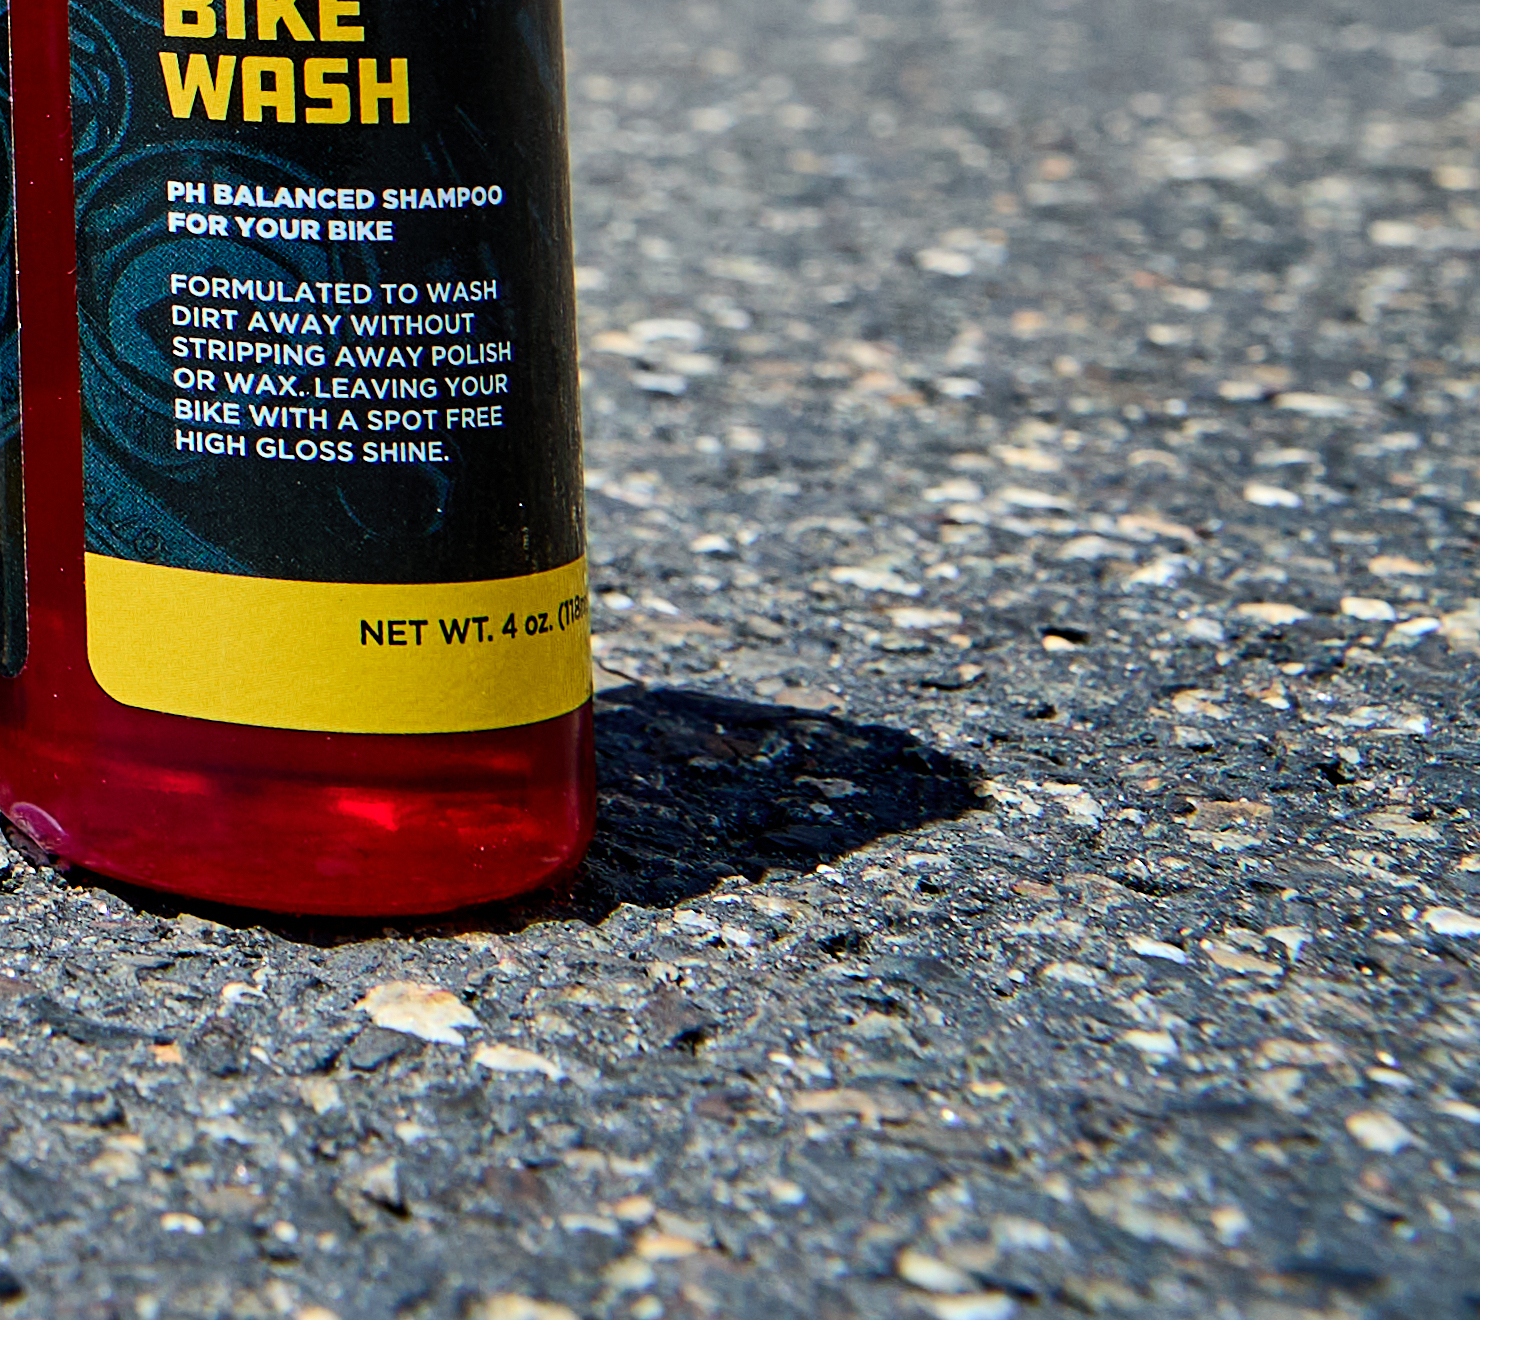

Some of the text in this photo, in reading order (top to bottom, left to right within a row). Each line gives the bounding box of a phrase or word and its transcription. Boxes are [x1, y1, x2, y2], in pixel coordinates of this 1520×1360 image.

[159, 52, 410, 124] WASH
[167, 180, 503, 210] PH BALANCED SHAMPOO
[167, 212, 394, 241] FOR YOUR BIKE
[170, 273, 497, 305] FORMULATED TO WASH
[171, 305, 475, 337] DIRT AWAY WITHOUT
[172, 336, 512, 369] STRIPPING AWAY POLISH
[173, 367, 216, 392] OR
[315, 376, 438, 399] LEAVING
[444, 374, 509, 397] YOUR
[174, 398, 503, 432] BIKE WITH A SPOT FREE
[175, 429, 450, 463] HIGH GLOSS SHINE.
[360, 619, 428, 646] NET
[438, 616, 493, 645] WT.
[501, 613, 518, 638] 4
[525, 612, 553, 636] oz.
